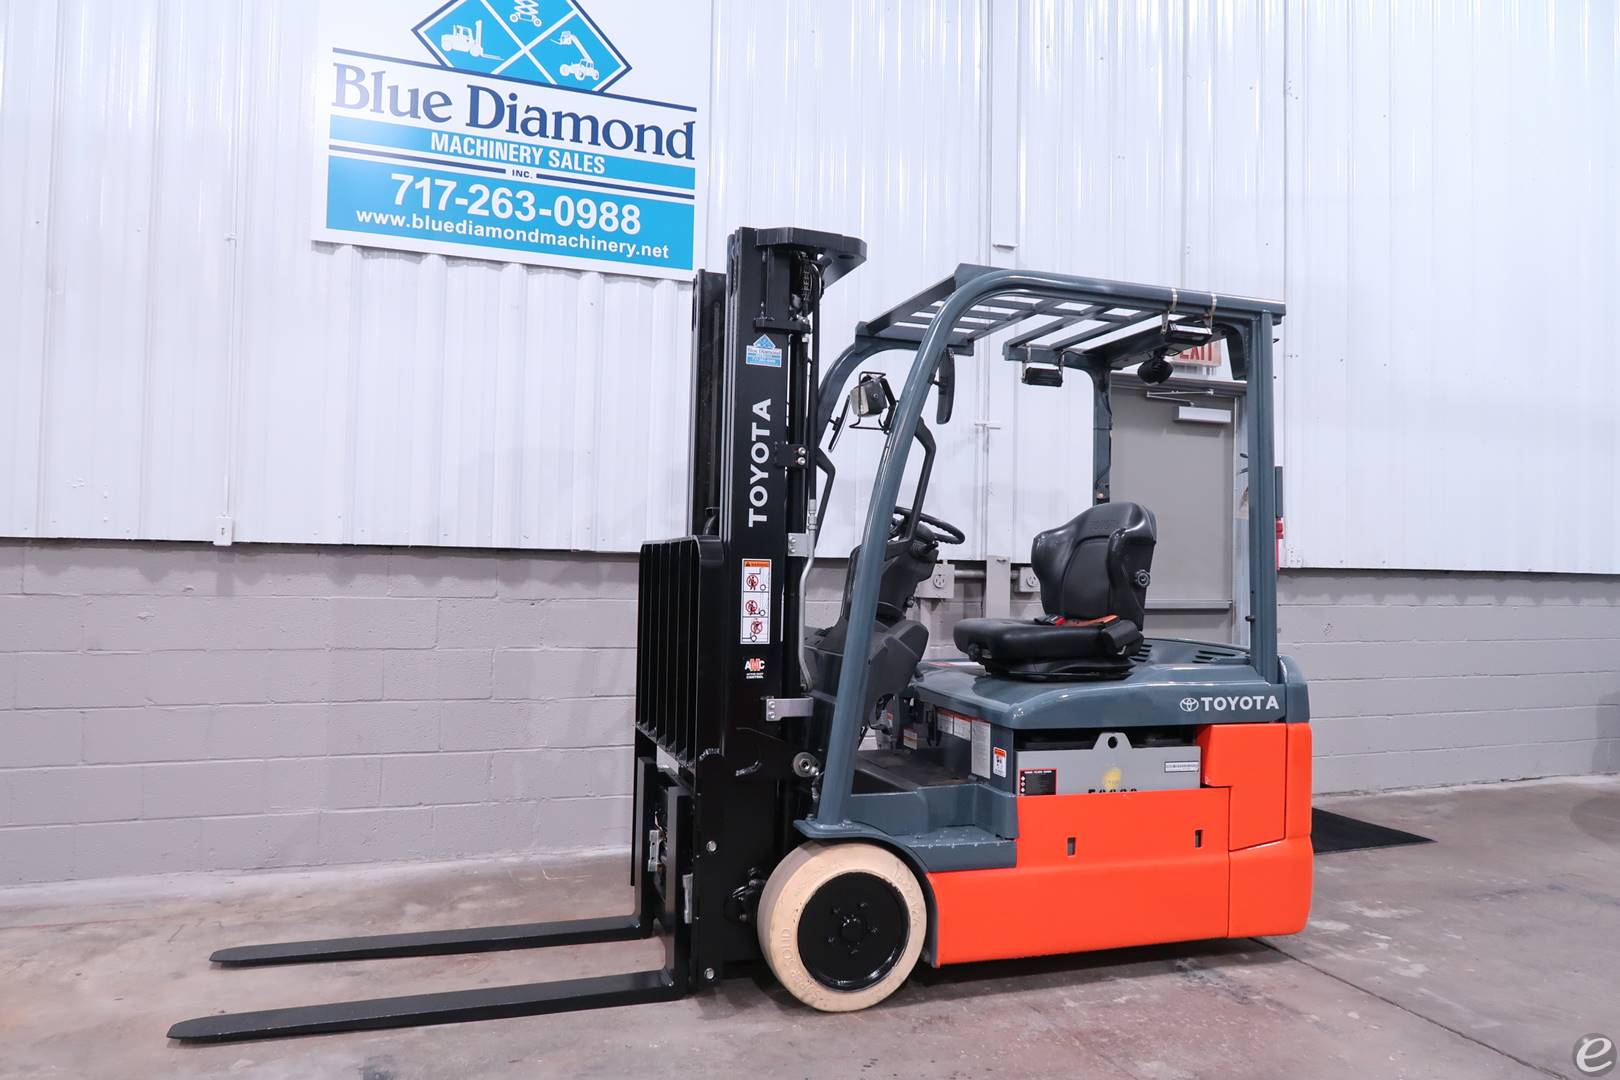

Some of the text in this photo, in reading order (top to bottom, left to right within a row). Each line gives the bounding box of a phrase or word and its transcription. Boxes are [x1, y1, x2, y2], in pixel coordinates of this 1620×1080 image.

[332, 62, 696, 160] Blue Diamond
[431, 132, 606, 175] MACHINERY SALES
[511, 169, 533, 179] INC.
[391, 173, 641, 235] 717-263-0988
[356, 209, 670, 259] www.bluediamondmachinery.net
[748, 398, 772, 528] TOYOTA
[1200, 695, 1280, 712] TOYOTA
